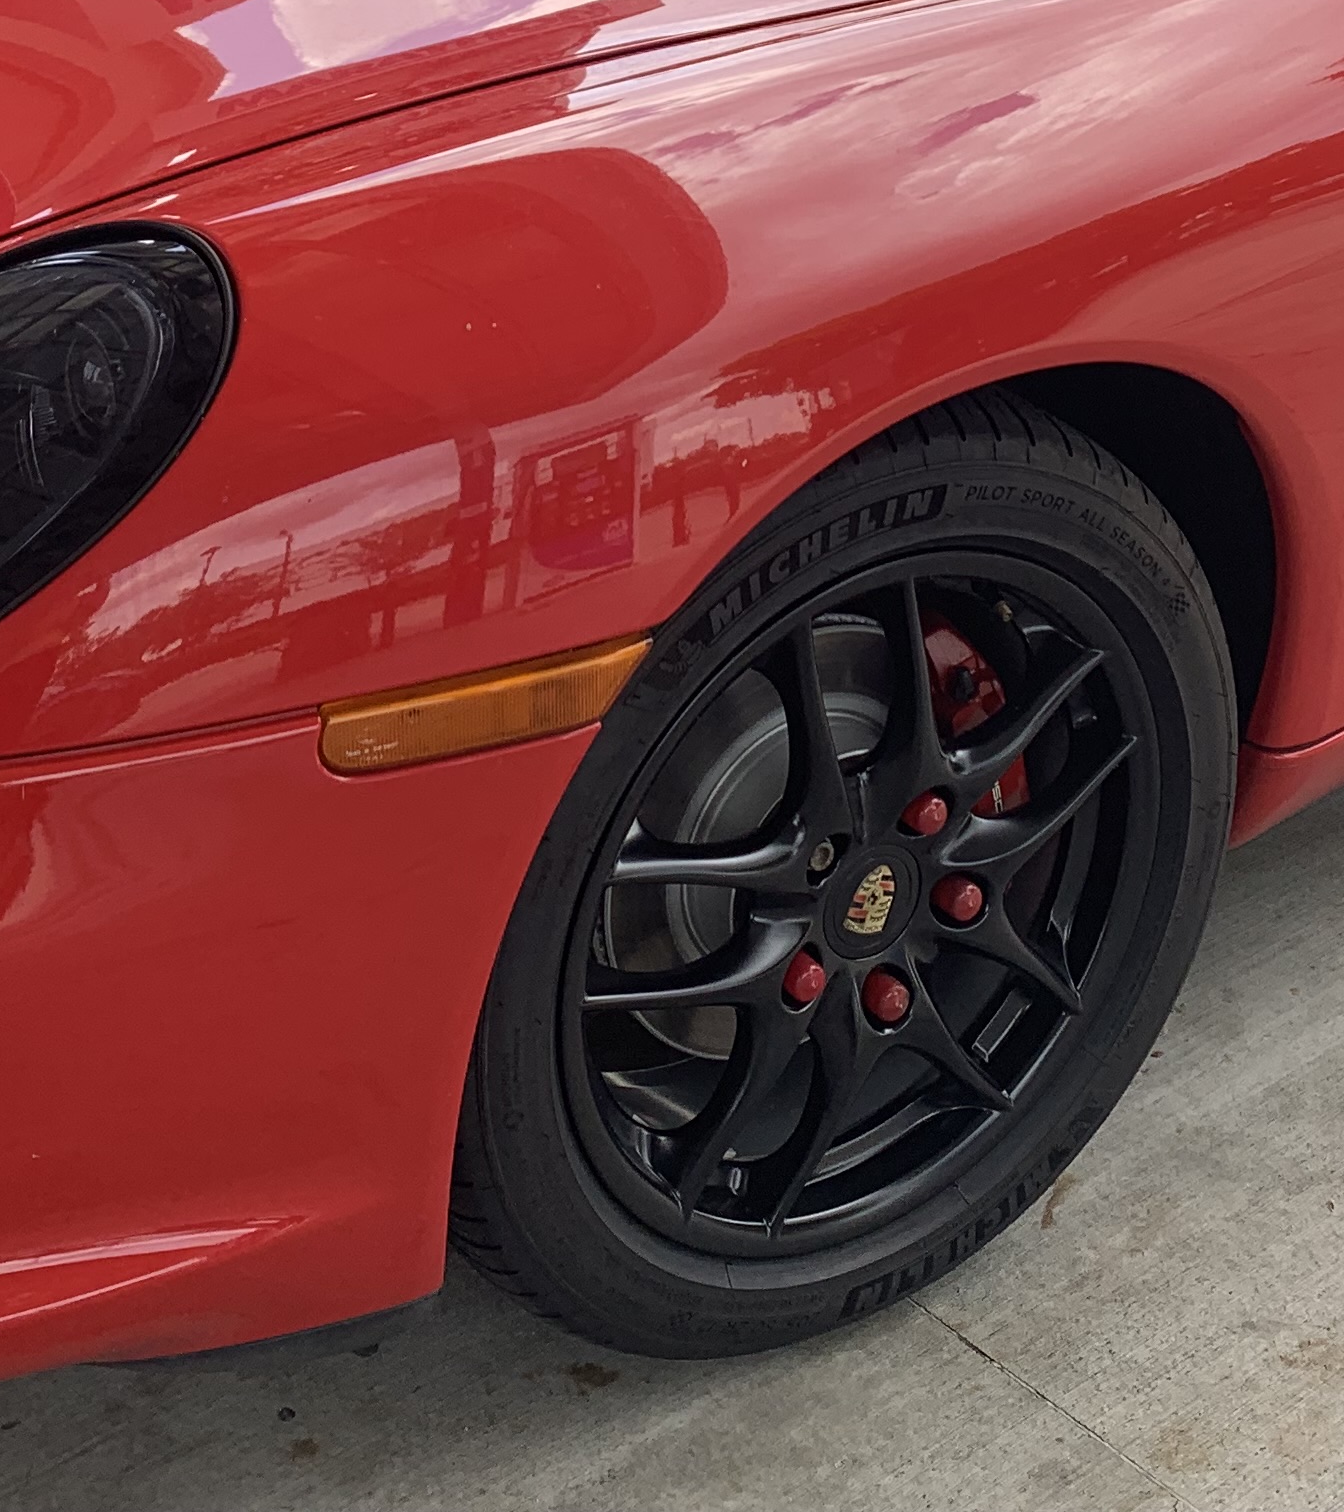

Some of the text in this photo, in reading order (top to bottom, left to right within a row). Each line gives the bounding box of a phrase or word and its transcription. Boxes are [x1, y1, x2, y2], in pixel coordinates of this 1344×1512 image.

[709, 488, 935, 635] MICHELIN
[964, 486, 1017, 502] PILOT
[1020, 489, 1076, 514] SPORT
[1078, 508, 1105, 533] ALL
[1109, 526, 1163, 578] SEASON
